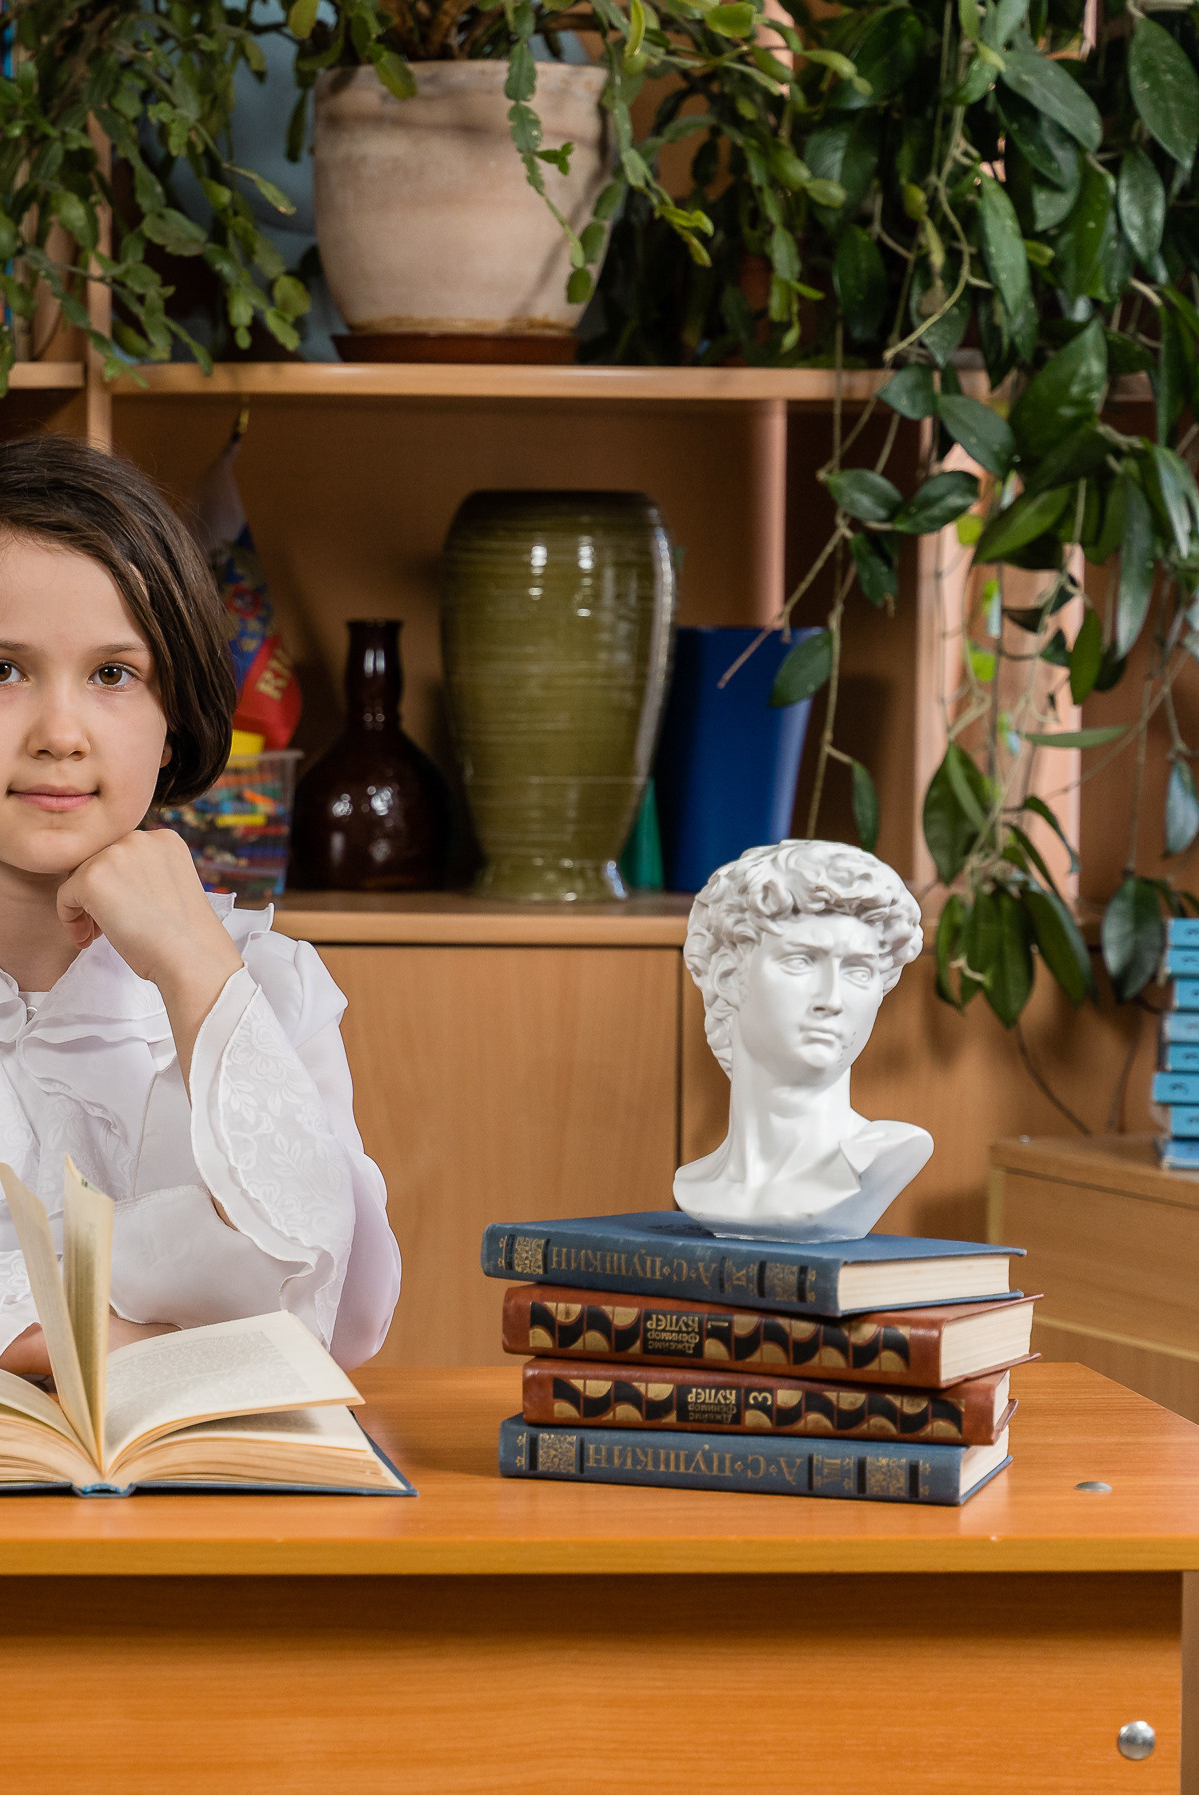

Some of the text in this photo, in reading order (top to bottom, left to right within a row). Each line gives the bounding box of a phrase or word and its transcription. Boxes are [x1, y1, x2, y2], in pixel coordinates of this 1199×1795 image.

[550, 1246, 663, 1281] ПУШКИН
[646, 1314, 699, 1332] КУПЕР
[647, 1330, 700, 1344] Фенимор
[648, 1341, 696, 1354] Джеймс
[687, 1387, 737, 1405] КУПЕР
[748, 1391, 772, 1406] 3
[688, 1402, 737, 1415] Фенимор
[585, 1443, 734, 1477] ПУШКИН
